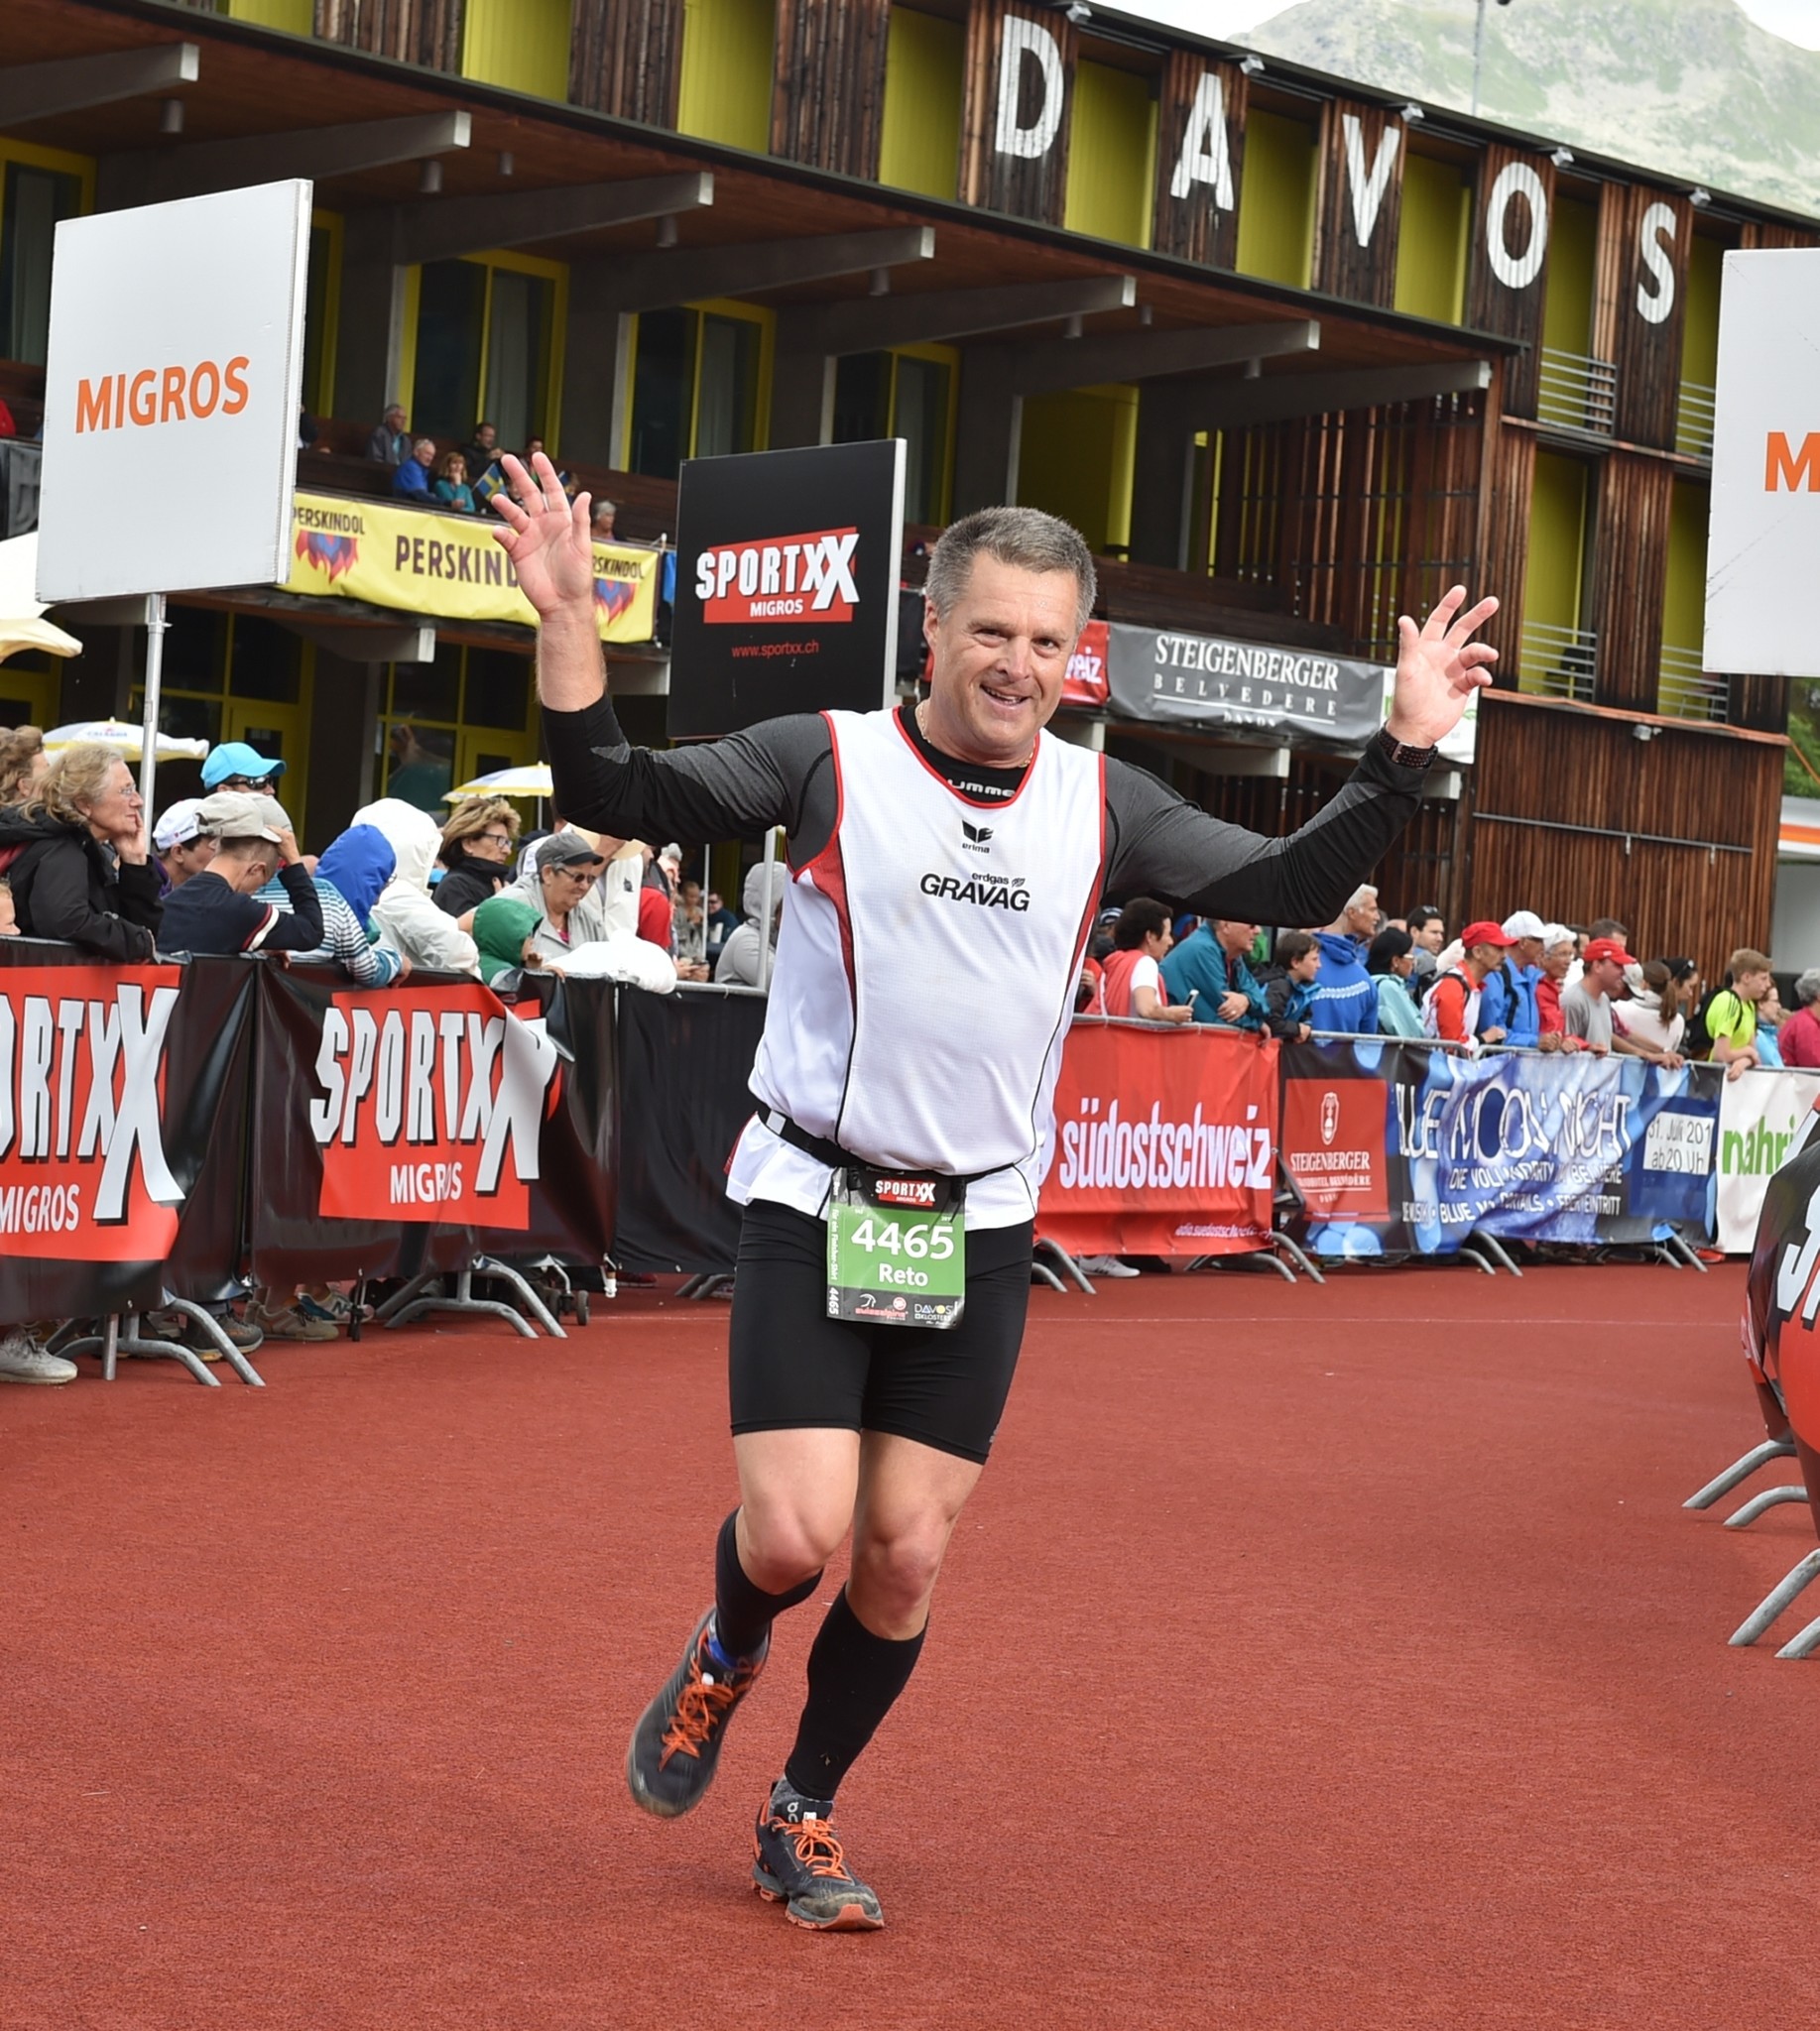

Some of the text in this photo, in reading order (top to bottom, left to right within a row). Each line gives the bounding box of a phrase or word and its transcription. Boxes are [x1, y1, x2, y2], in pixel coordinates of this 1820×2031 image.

[75, 356, 250, 433] MIGROS
[695, 534, 860, 610] SPORTXX
[750, 599, 803, 617] MIGROS
[731, 640, 819, 659] www.sportxx.ch
[1154, 635, 1339, 691] STEIGENBERGER
[1153, 673, 1336, 716] BELVEDERE
[962, 843, 990, 854] erima
[971, 872, 1010, 886] erdgas
[920, 873, 1031, 911] GRAVAG
[1059, 1097, 1272, 1190] südostschweiz
[1290, 1151, 1370, 1171] STEIGENBERGER
[1651, 1147, 1665, 1169] ab
[1666, 1148, 1683, 1172] 20
[390, 1161, 462, 1204] MIGROS
[1449, 1167, 1469, 1190] DIE
[875, 1180, 935, 1203] SPORTXX
[1439, 1202, 1476, 1224] BLUE
[851, 1220, 954, 1259] 4465
[879, 1263, 928, 1287] Reto
[828, 1287, 839, 1315] 4465
